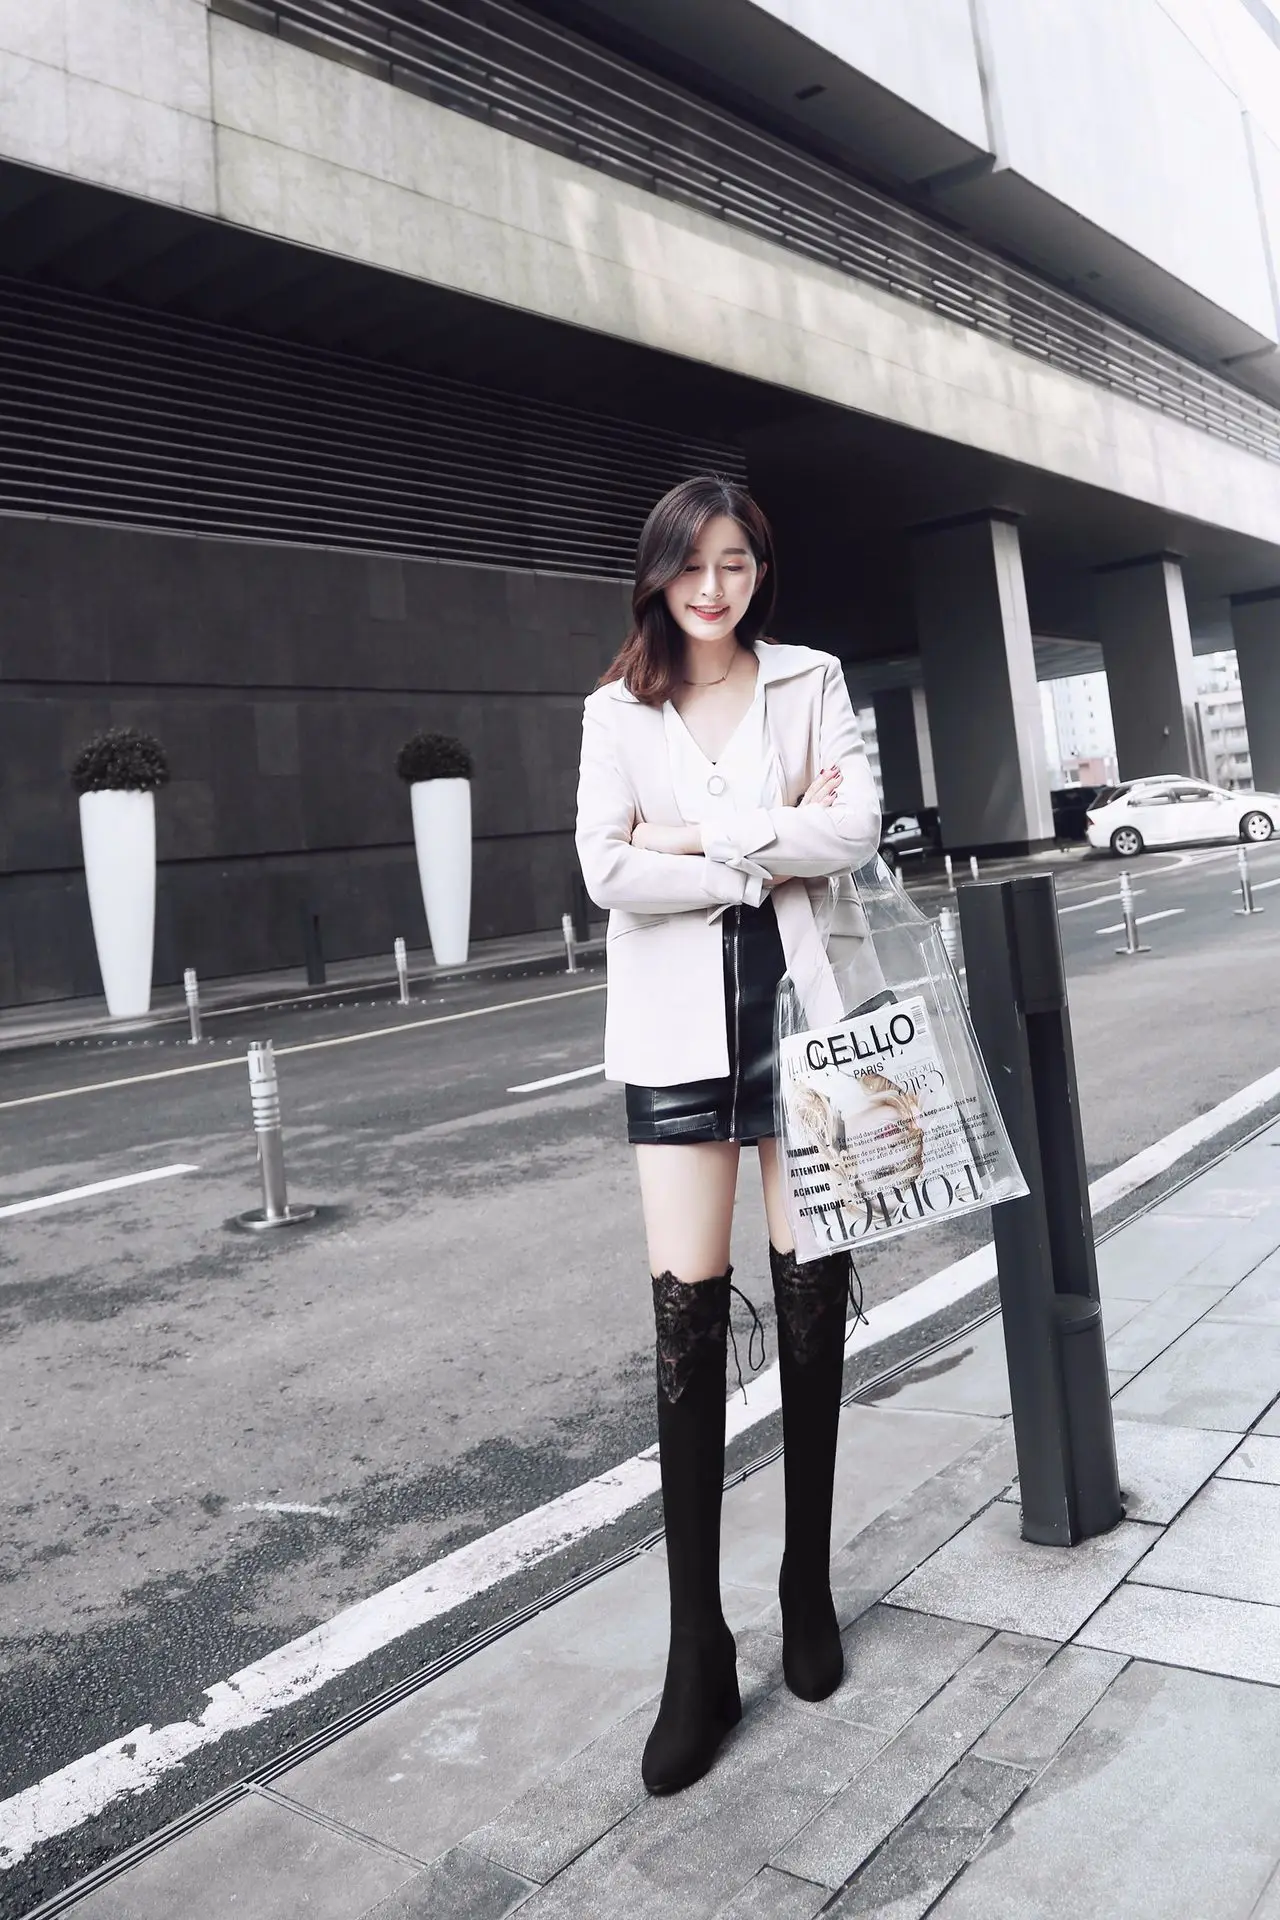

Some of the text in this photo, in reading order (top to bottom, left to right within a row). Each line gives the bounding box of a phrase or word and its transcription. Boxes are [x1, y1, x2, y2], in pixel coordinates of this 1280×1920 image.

[807, 1014, 914, 1070] CELLO
[853, 1062, 885, 1079] PARIS
[923, 1107, 937, 1116] keep
[786, 1144, 820, 1159] WARNING
[790, 1162, 831, 1178] ATTENTION
[793, 1183, 831, 1198] ACHTUNG
[798, 1199, 846, 1218] ATTENZIONE
[820, 1164, 983, 1242] PORTER
